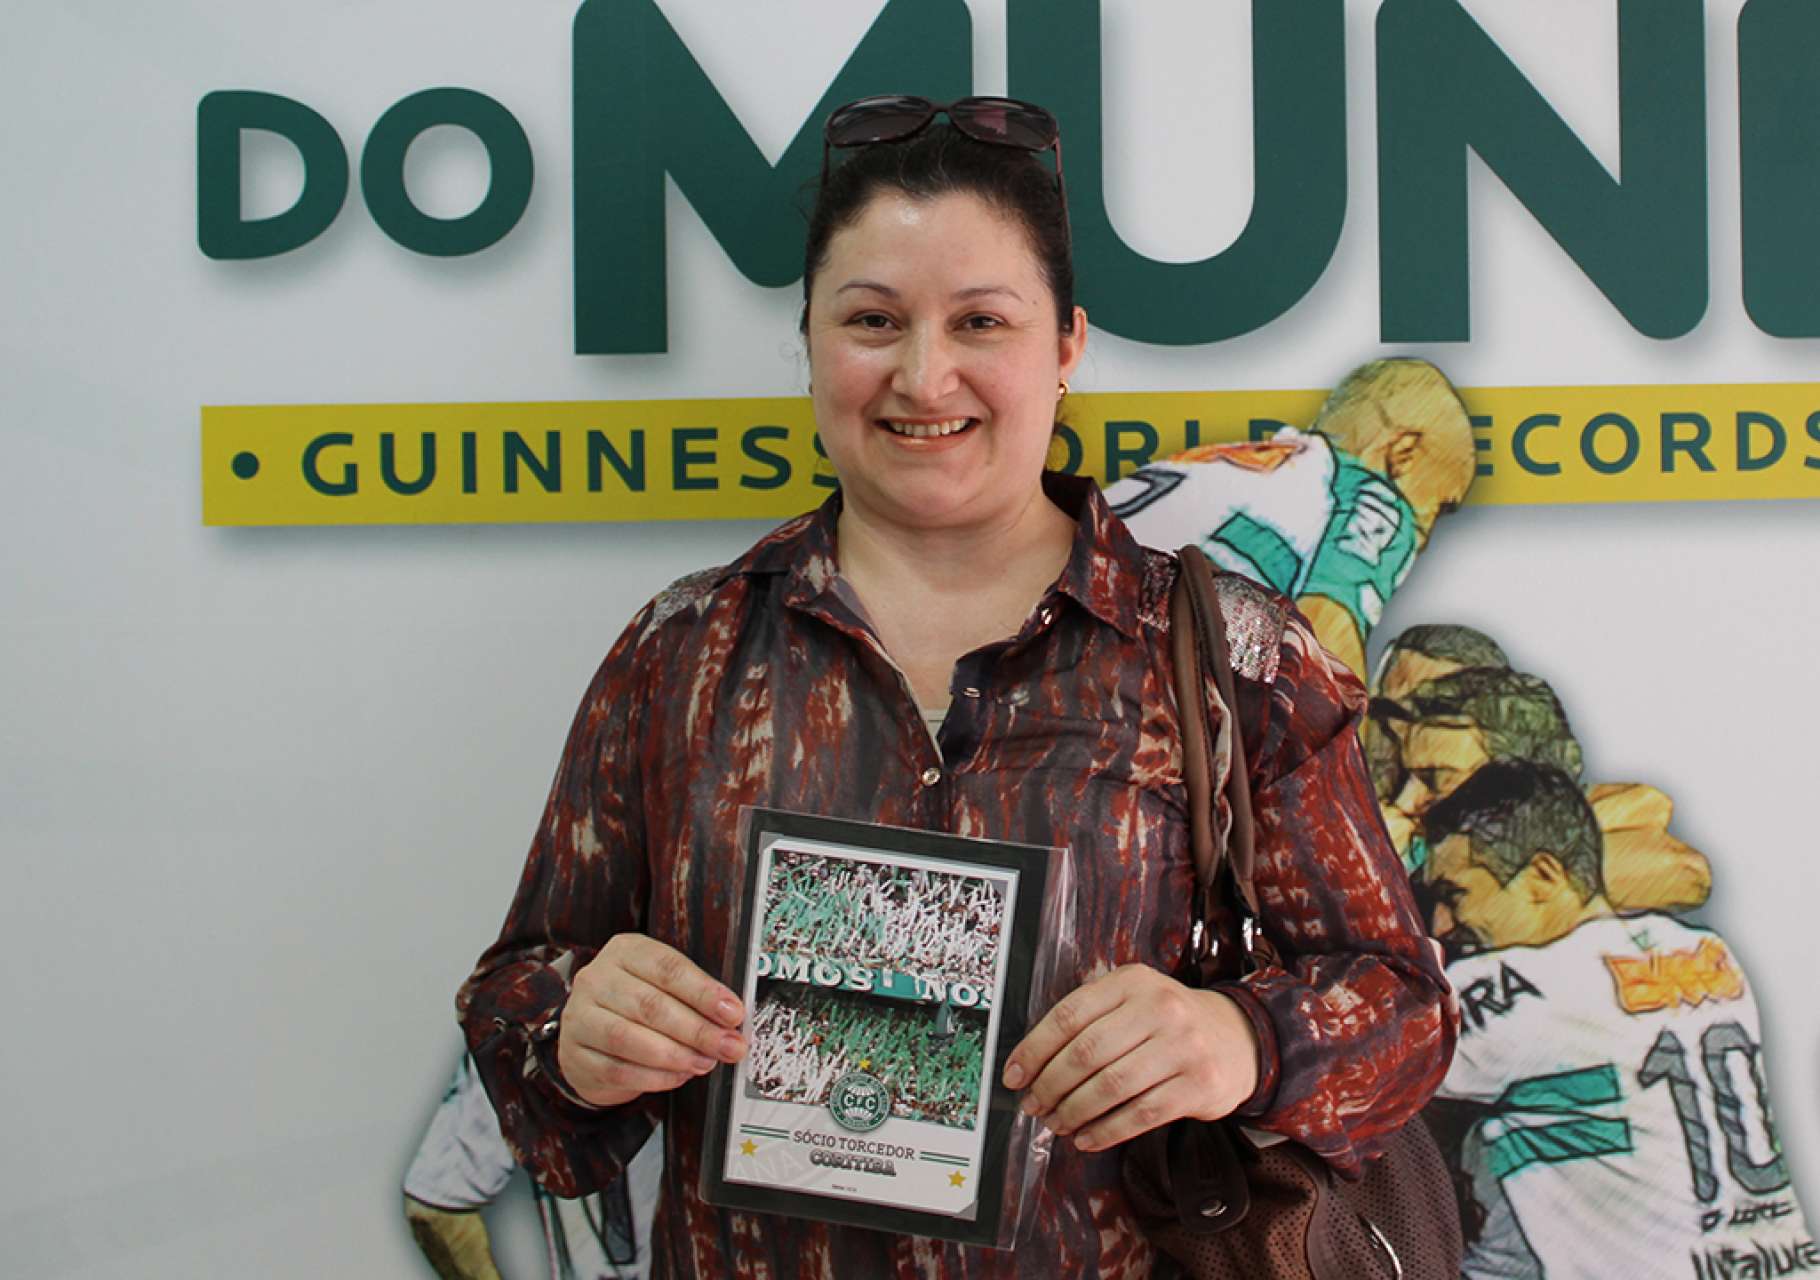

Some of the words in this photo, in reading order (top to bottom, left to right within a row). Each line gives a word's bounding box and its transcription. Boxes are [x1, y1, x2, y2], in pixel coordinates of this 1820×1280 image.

[197, 87, 534, 260] DO
[793, 1129, 836, 1148] SÓCIO
[838, 1137, 915, 1161] TORCEDOR
[1638, 1022, 1792, 1203] 10
